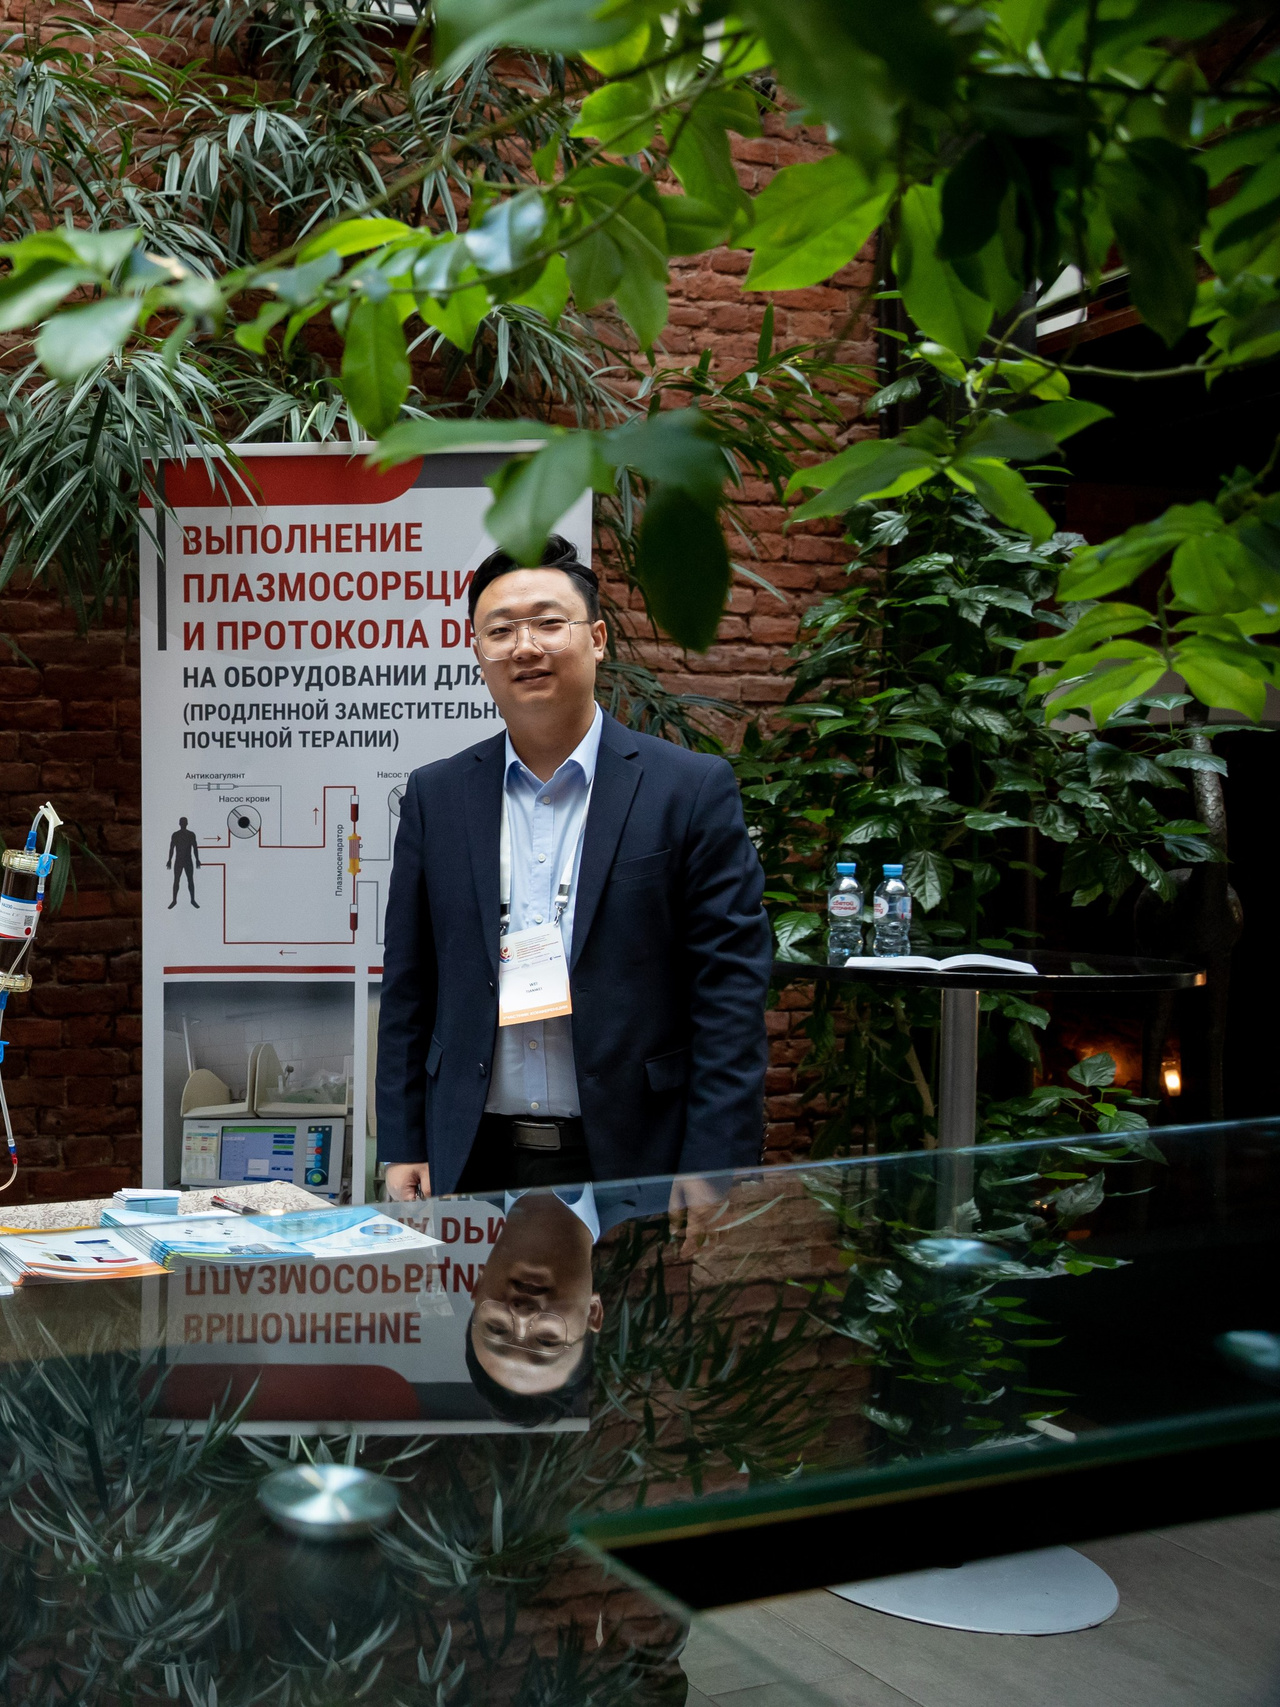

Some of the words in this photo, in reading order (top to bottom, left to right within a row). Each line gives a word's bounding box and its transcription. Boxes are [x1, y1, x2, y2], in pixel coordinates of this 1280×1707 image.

[183, 522, 423, 555] ВЫПОЛНЕНИЕ
[183, 621, 205, 651] И
[217, 619, 430, 651] ПРОТОКОЛА
[183, 667, 217, 689] НА
[224, 663, 427, 692] ОБОРУДОВАНИИ
[434, 664, 486, 691] ДЛЯ
[183, 698, 329, 726] (ПРОДЛЕННОЙ
[183, 726, 292, 749] ПОЧЕЧНОЙ
[298, 728, 400, 752] ТЕРАПИИ)
[185, 772, 246, 781] Антикоагулянт
[376, 771, 403, 779] Насос
[219, 795, 243, 803] Насос
[245, 796, 270, 804] крови
[335, 824, 344, 896] Плазмосепаратор
